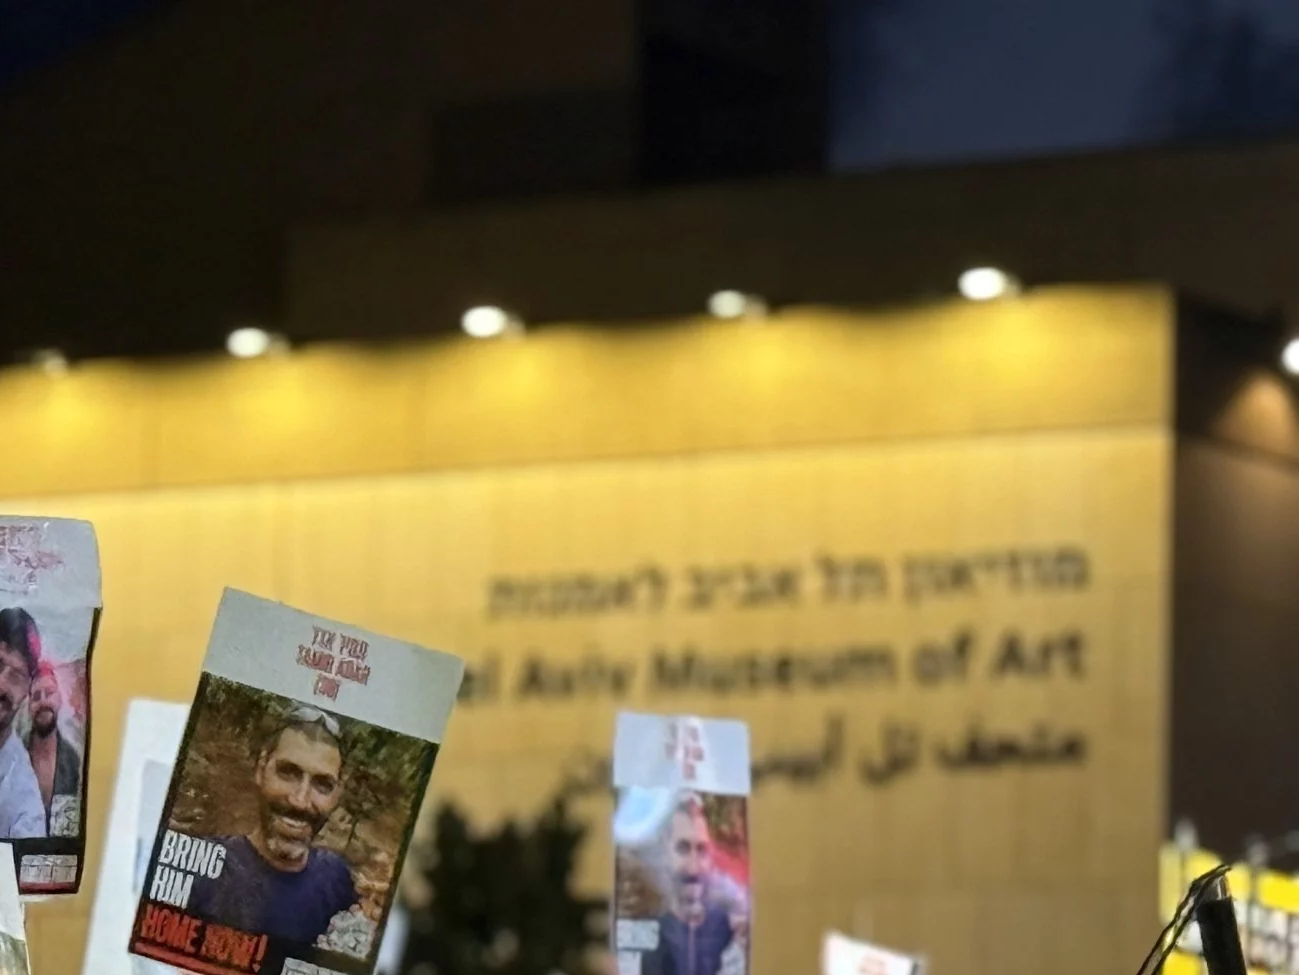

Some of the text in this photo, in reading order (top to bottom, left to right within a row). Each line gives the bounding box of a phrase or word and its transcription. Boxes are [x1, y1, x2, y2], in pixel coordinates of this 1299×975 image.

[457, 652, 500, 704] el
[650, 642, 895, 694] Museum
[913, 626, 971, 685] of
[993, 629, 1083, 680] Art
[158, 829, 227, 879] BRING
[150, 865, 195, 909] HIM
[140, 903, 202, 953] HOME
